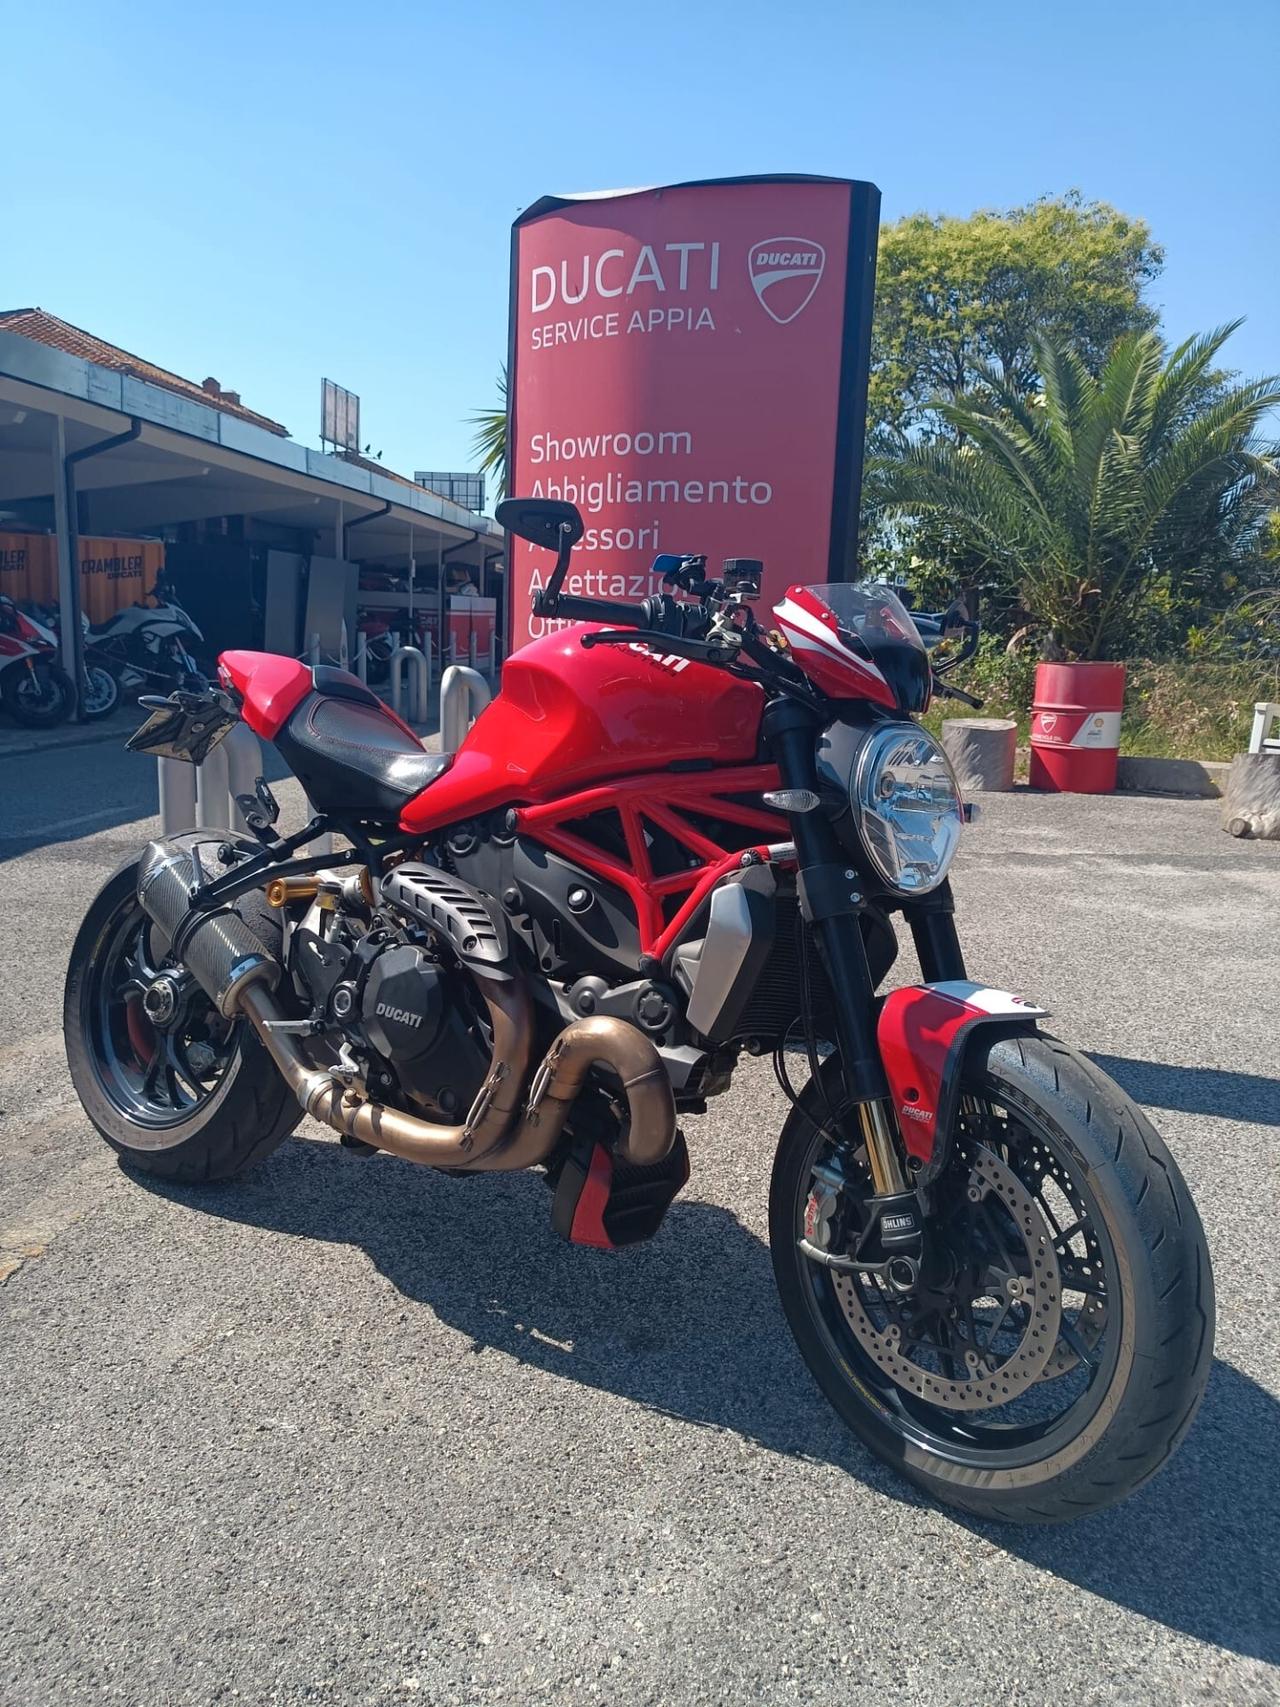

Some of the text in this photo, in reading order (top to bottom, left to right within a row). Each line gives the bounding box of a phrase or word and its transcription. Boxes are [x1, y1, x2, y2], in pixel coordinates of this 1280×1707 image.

[756, 252, 817, 266] DUCATI
[531, 242, 719, 313] DUCATI
[531, 307, 716, 350] SERVICE APPIA
[530, 431, 692, 463] Showroom
[531, 473, 772, 512] Abbigliamento
[528, 520, 660, 552] ssori
[81, 556, 142, 575] CRAMBLER
[376, 1003, 423, 1028] DUCATI
[902, 1105, 933, 1119] DUCATI
